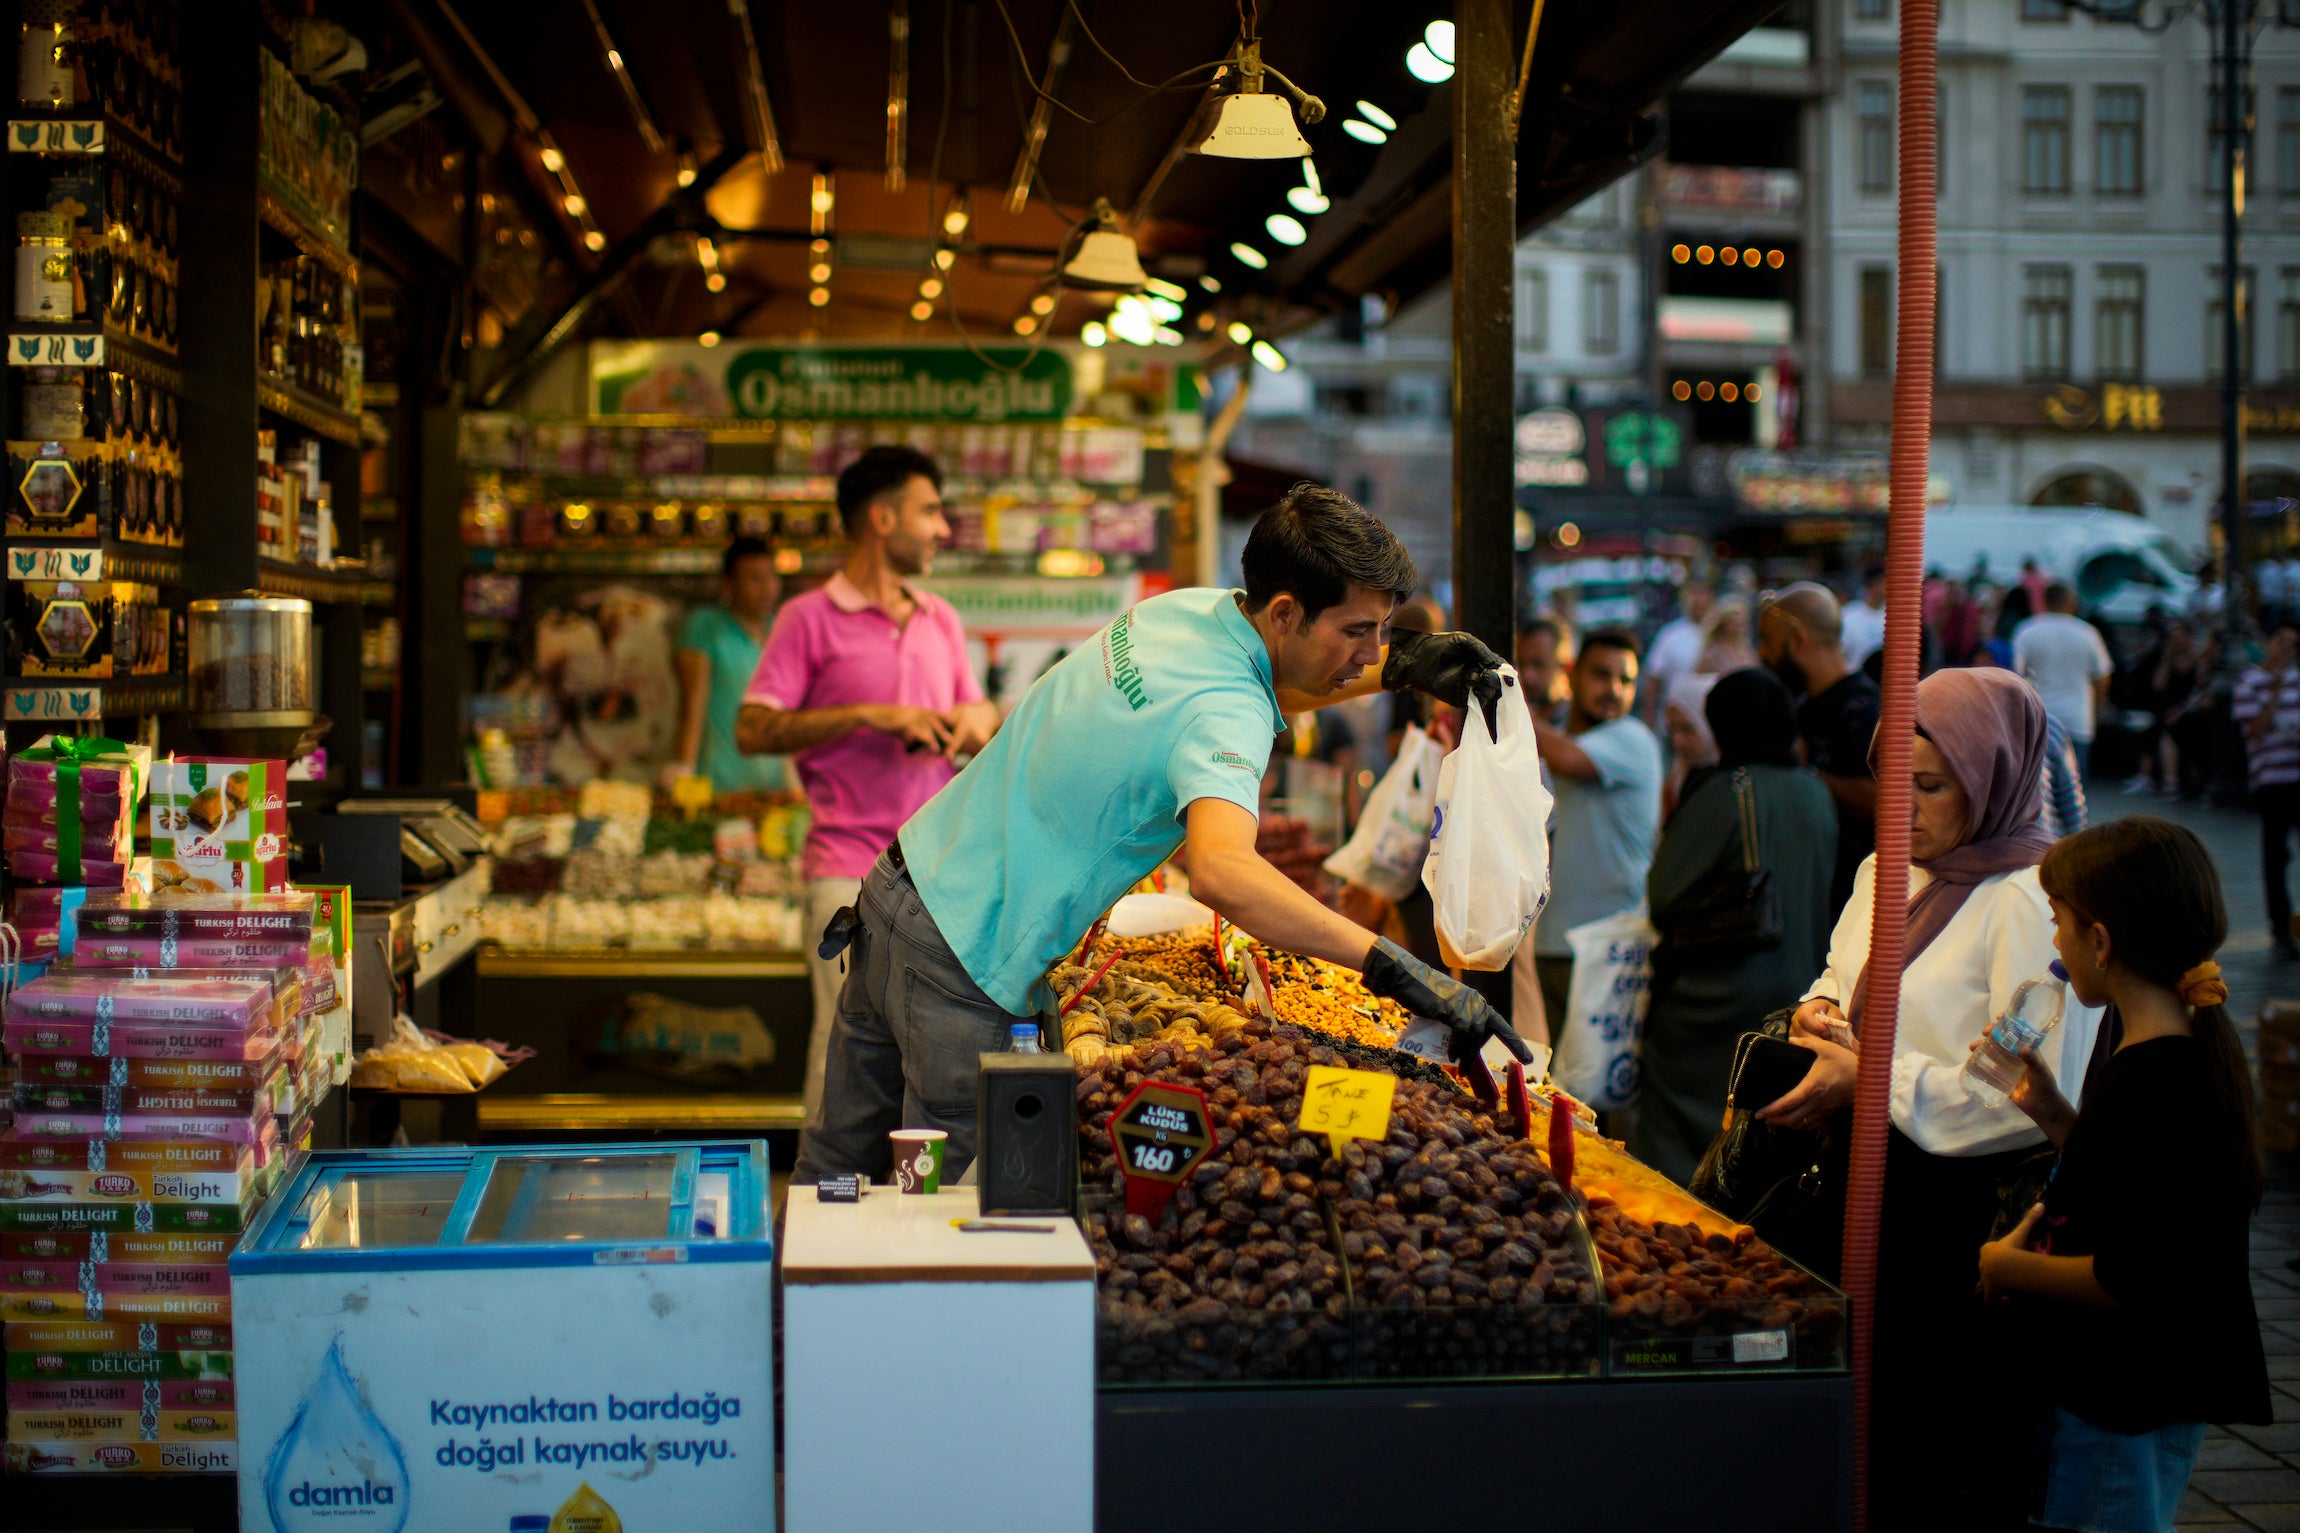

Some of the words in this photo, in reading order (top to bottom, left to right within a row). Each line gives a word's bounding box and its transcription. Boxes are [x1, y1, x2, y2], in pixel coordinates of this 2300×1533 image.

[194, 918, 234, 928] TURKISH
[237, 917, 292, 928] DELIGHT
[193, 947, 232, 956] TURKISH
[235, 946, 290, 956] DELIGHT
[132, 1009, 169, 1017] TURKISH
[173, 1007, 226, 1019] DELIGHT
[126, 1036, 166, 1046] TURKISH
[169, 1036, 225, 1048] DELIGHT
[144, 1065, 184, 1075] TURKISH
[187, 1064, 243, 1077] DELIGHT
[137, 1097, 193, 1109] DELIGHT
[196, 1097, 237, 1107] TURKISH
[1147, 1105, 1186, 1121] LÜKS
[48, 1120, 71, 1128] TURKO
[145, 1125, 180, 1133] TURKISH
[182, 1122, 230, 1134] DELIGHT
[1139, 1114, 1189, 1133] KUDÜS
[1155, 1130, 1167, 1141] KG
[122, 1151, 162, 1159] TURKISH
[166, 1149, 222, 1161] DELIGHT
[1134, 1144, 1174, 1172] 160
[99, 1176, 130, 1187] TURKO
[153, 1175, 183, 1183] Turkish
[154, 1182, 221, 1200] Delight
[17, 1212, 58, 1221] TURKISH
[61, 1210, 118, 1221] DELIGHT
[124, 1243, 165, 1252] TURKISH
[168, 1241, 224, 1252] DELIGHT
[112, 1273, 153, 1282] TURKISH
[156, 1271, 212, 1283] DELIGHT
[120, 1303, 160, 1312] TURKISH
[163, 1301, 220, 1313] DELIGHT
[29, 1331, 64, 1340] TURKISH
[67, 1329, 115, 1340] DELIGHT
[189, 1328, 213, 1337] TURKO
[36, 1355, 63, 1364] TURKO
[1624, 1352, 1677, 1364] MERCAN
[91, 1358, 163, 1373] DELIGHT
[26, 1390, 67, 1399] TURKISH
[70, 1387, 126, 1399] DELIGHT
[431, 1395, 597, 1431] Kaynaktan
[608, 1392, 740, 1426] bardağa
[25, 1420, 65, 1429] TURKISH
[68, 1417, 124, 1429] DELIGHT
[99, 1447, 131, 1457] TURKO
[160, 1444, 191, 1453] Turkish
[436, 1436, 524, 1473] doğal
[535, 1434, 647, 1470] kaynak
[657, 1438, 736, 1466] suyu.
[161, 1452, 229, 1469] Delight
[289, 1479, 394, 1506] damla
[312, 1508, 332, 1517] Doğal
